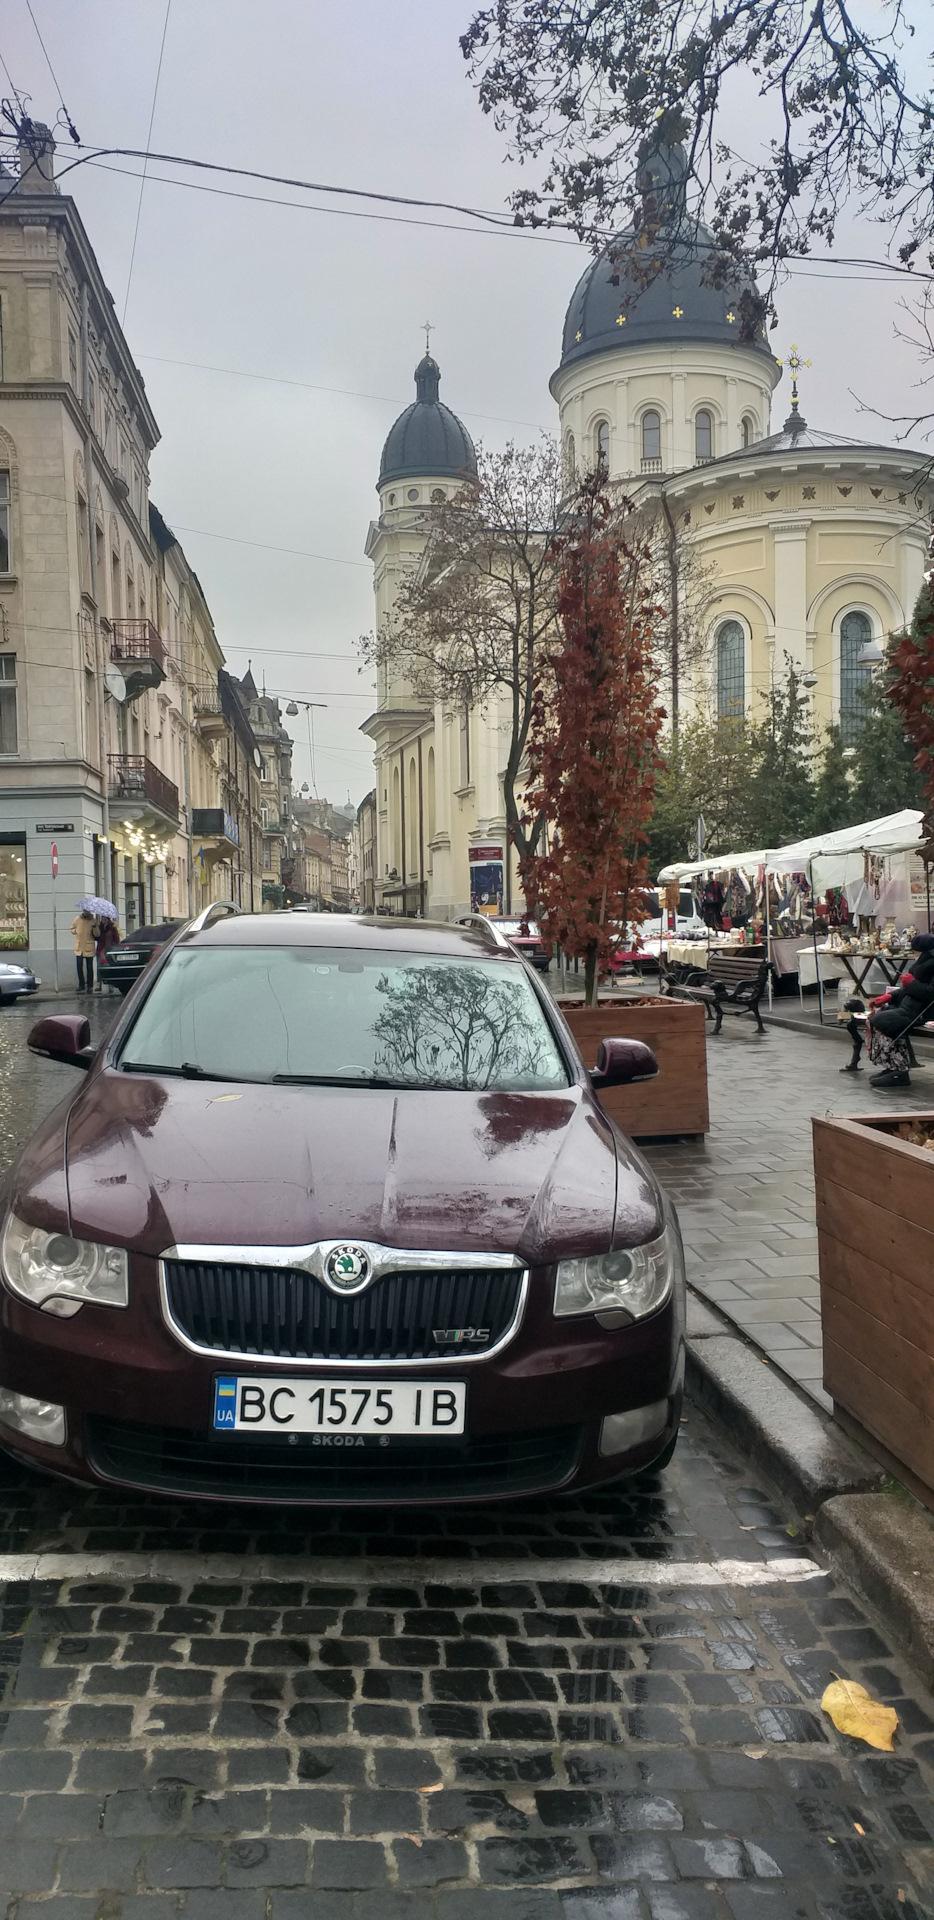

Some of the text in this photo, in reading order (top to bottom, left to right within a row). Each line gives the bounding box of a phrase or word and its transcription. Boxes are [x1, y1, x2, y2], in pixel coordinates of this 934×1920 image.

[239, 1385, 458, 1426] BC 1575 IB
[217, 1410, 234, 1422] UA
[312, 1435, 365, 1446] ŠKODA
